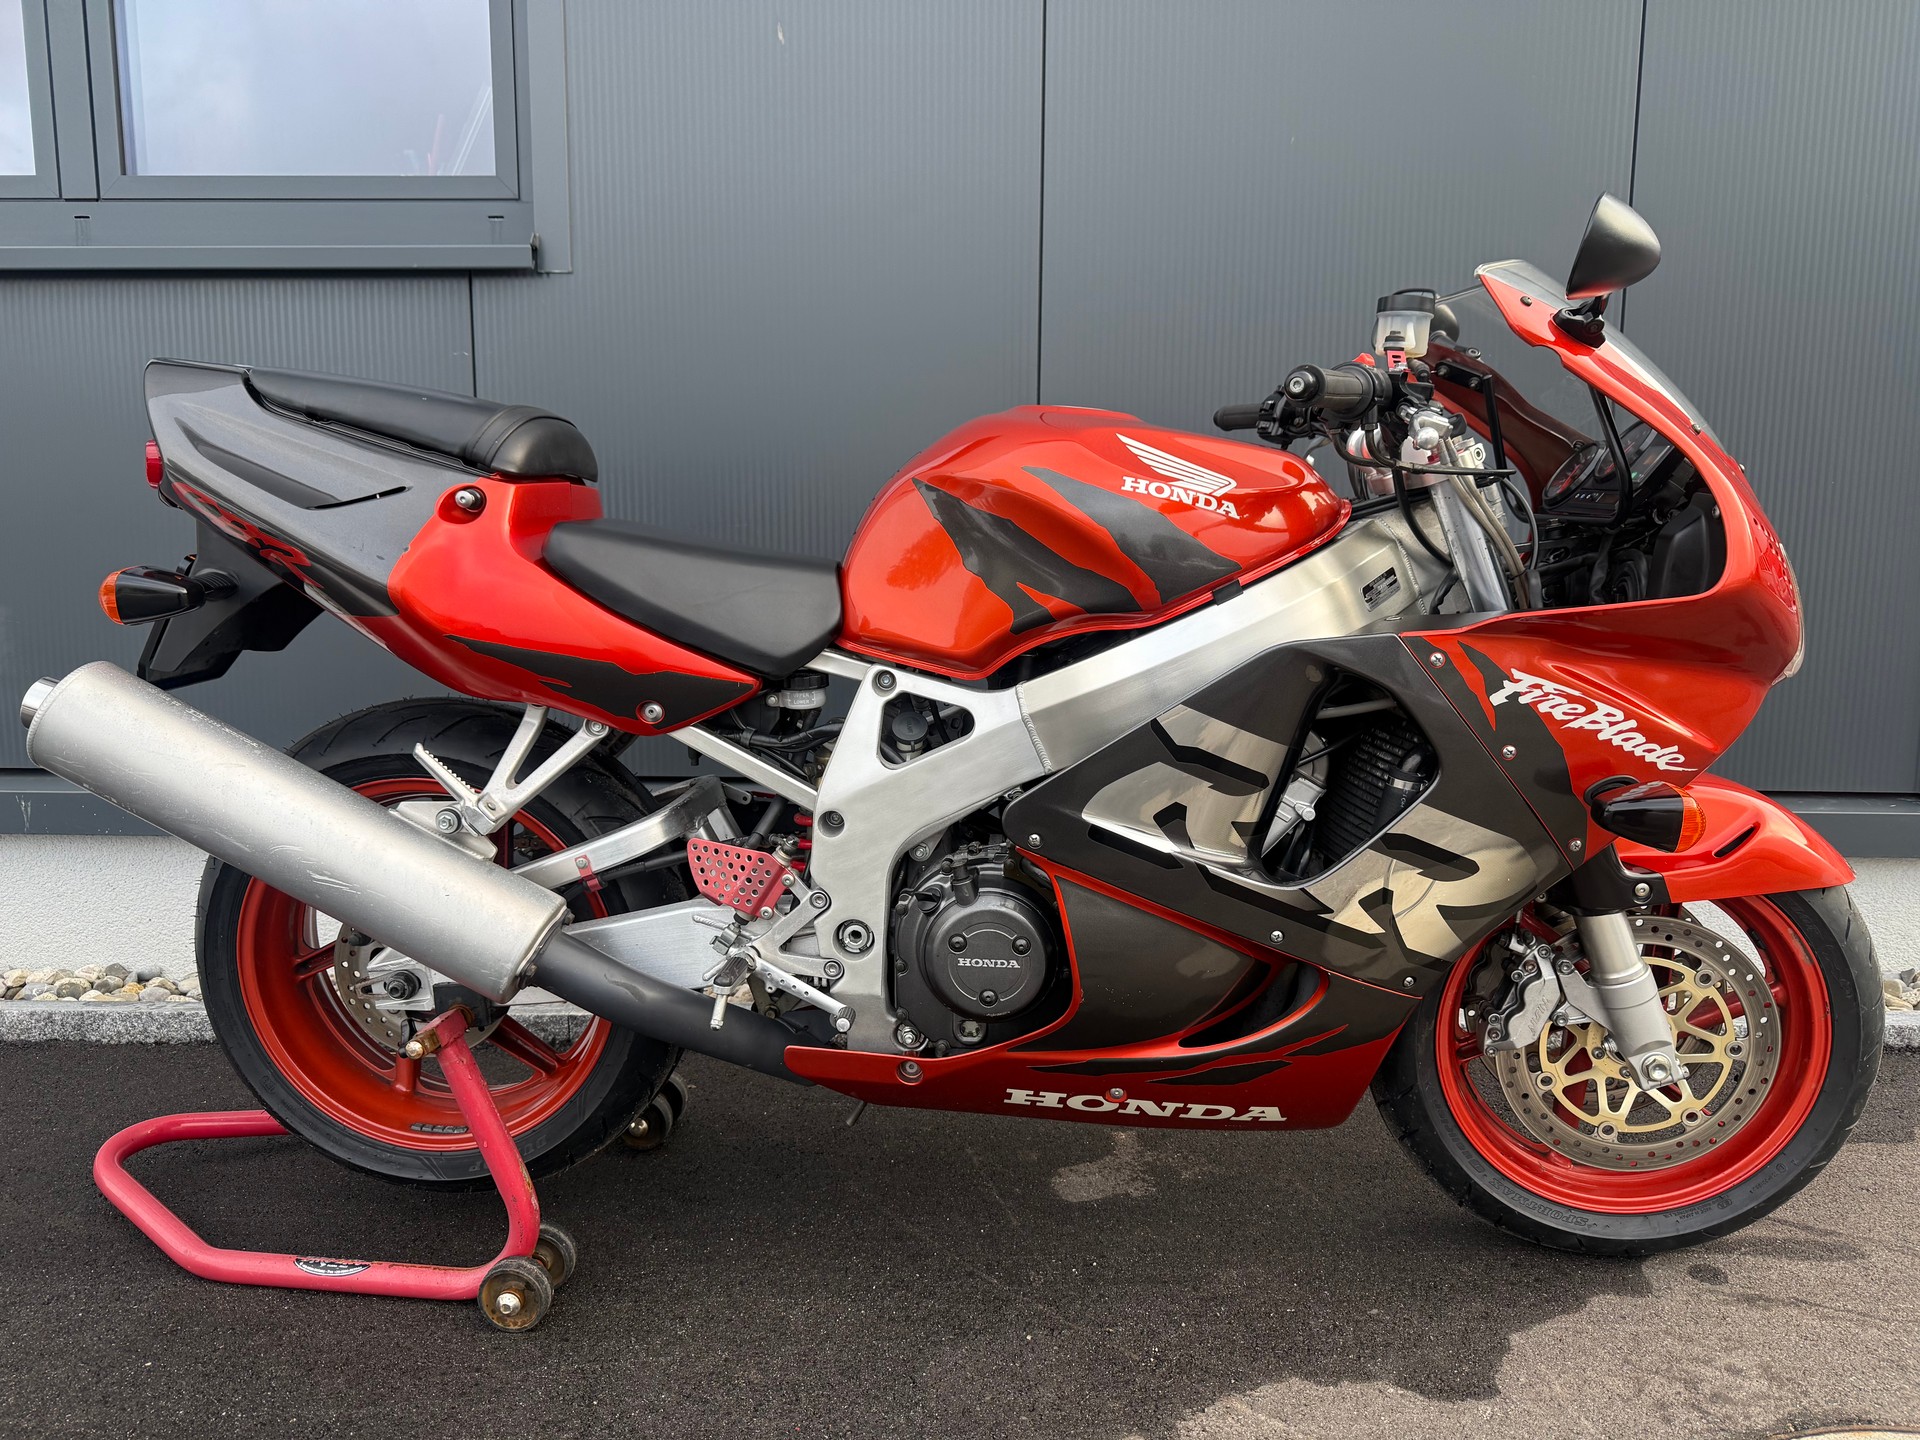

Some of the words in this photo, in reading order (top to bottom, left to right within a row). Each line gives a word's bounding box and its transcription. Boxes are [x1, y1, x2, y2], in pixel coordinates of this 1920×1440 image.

[1120, 476, 1240, 519] HONDA
[1489, 668, 1698, 772] FireBlade
[957, 957, 1021, 969] HONDA
[1003, 1088, 1287, 1122] HONDA
[1489, 1177, 1591, 1228] SPORTMAX
